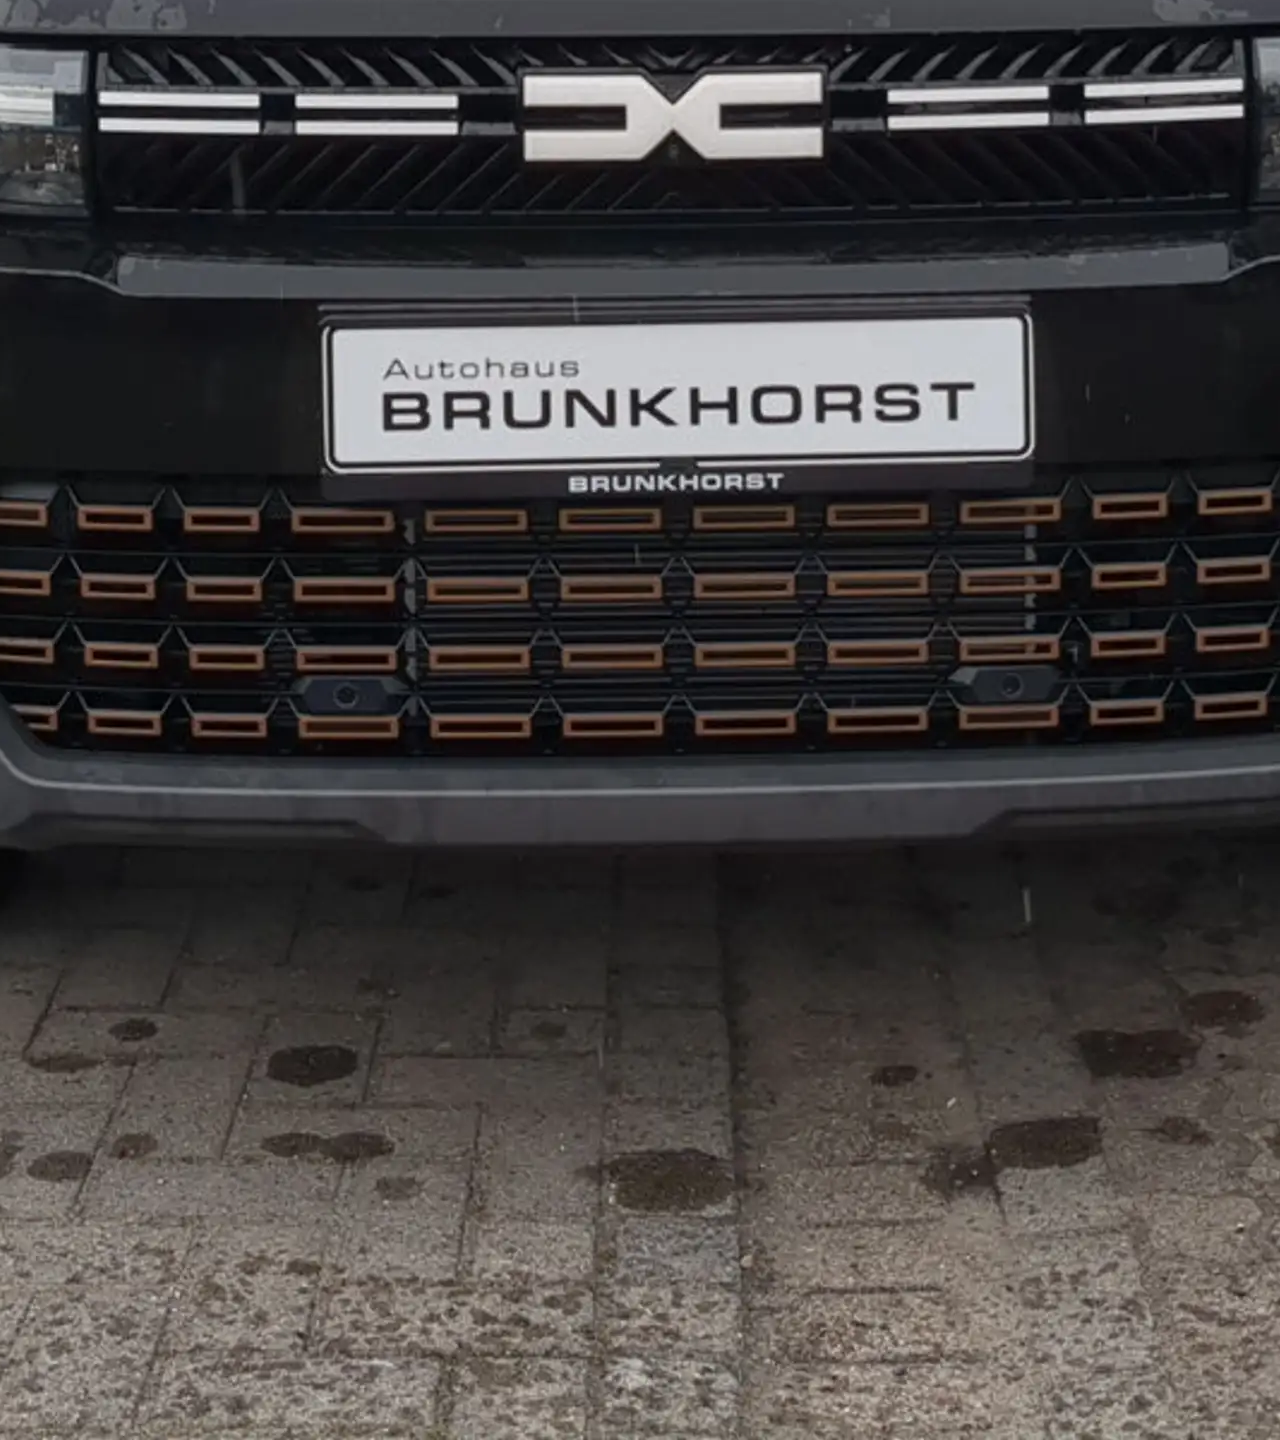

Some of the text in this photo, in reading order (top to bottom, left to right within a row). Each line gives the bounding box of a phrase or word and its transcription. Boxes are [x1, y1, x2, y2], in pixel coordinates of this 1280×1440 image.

[383, 357, 580, 381] Autohaus
[382, 383, 975, 431] BRUNKHORST
[568, 473, 785, 494] BRUNKHORST
